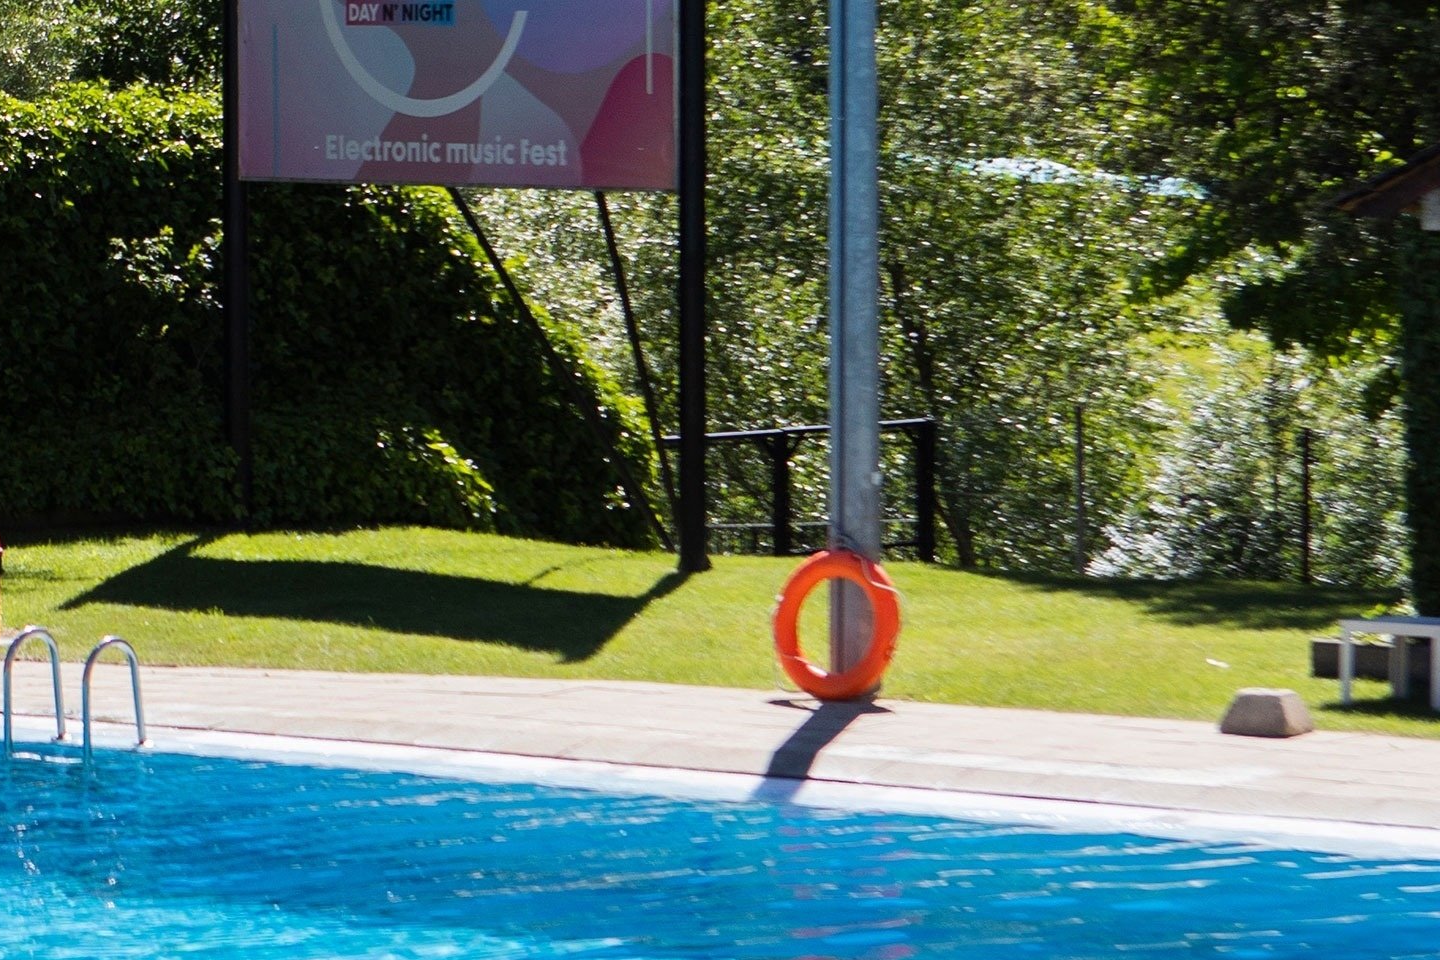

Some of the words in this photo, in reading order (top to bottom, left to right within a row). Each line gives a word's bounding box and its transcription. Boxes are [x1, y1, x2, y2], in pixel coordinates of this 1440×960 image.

[349, 3, 380, 22] DAY
[402, 3, 453, 22] NIGHT
[325, 133, 441, 163] Electronic
[446, 135, 516, 165] music
[520, 138, 567, 166] fest
